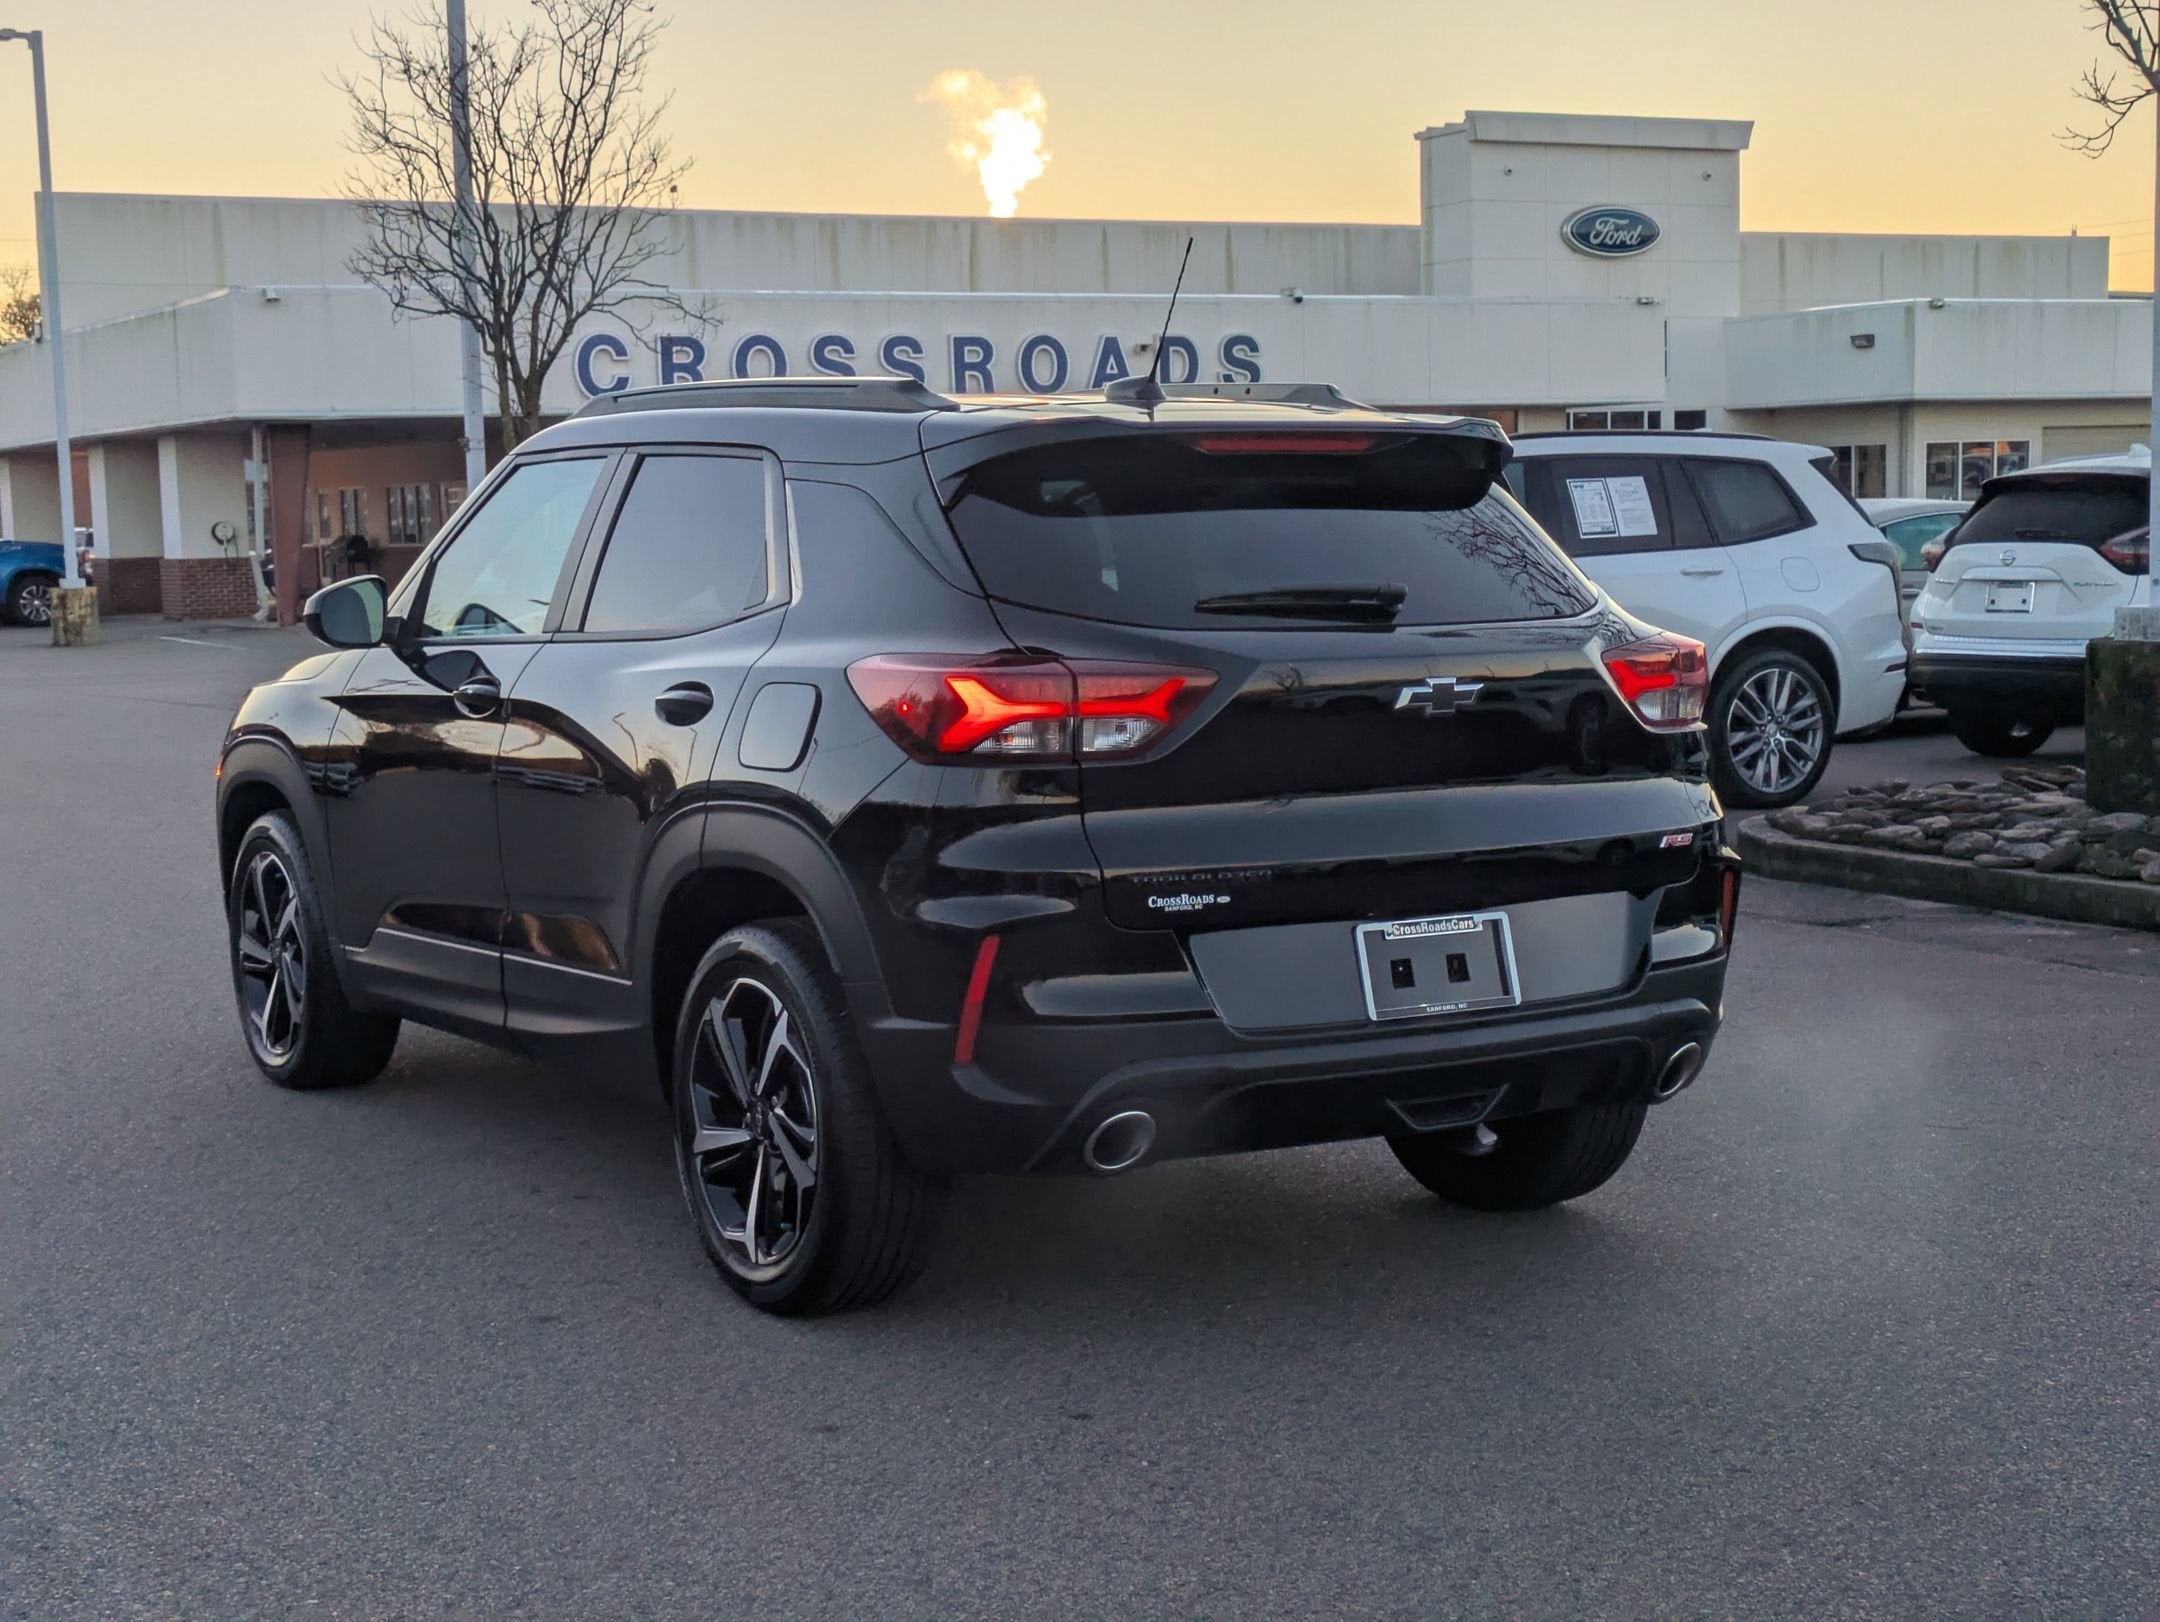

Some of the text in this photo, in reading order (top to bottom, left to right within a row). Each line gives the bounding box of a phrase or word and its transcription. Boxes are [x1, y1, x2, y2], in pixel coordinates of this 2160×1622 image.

[1589, 217, 1643, 245] Ford
[573, 331, 1264, 397] CROSSROADS
[1660, 832, 1694, 849] RS
[1392, 918, 1475, 936] CrossRoadsCars
